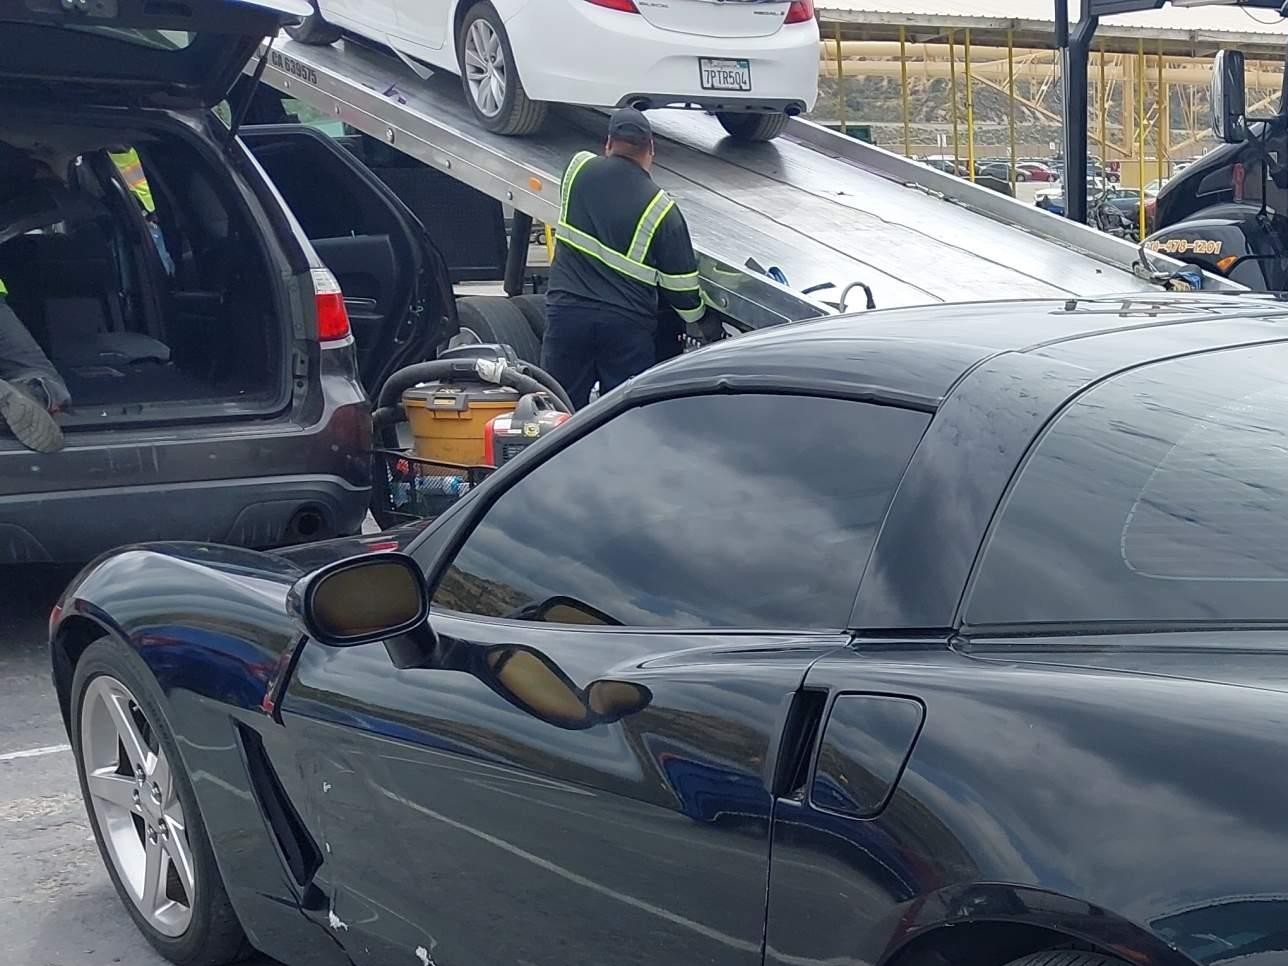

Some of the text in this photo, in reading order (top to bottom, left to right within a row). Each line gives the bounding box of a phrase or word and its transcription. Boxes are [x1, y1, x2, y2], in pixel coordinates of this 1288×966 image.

[271, 51, 284, 69] CA
[285, 57, 318, 84] 639575
[704, 70, 747, 86] 7PTR504
